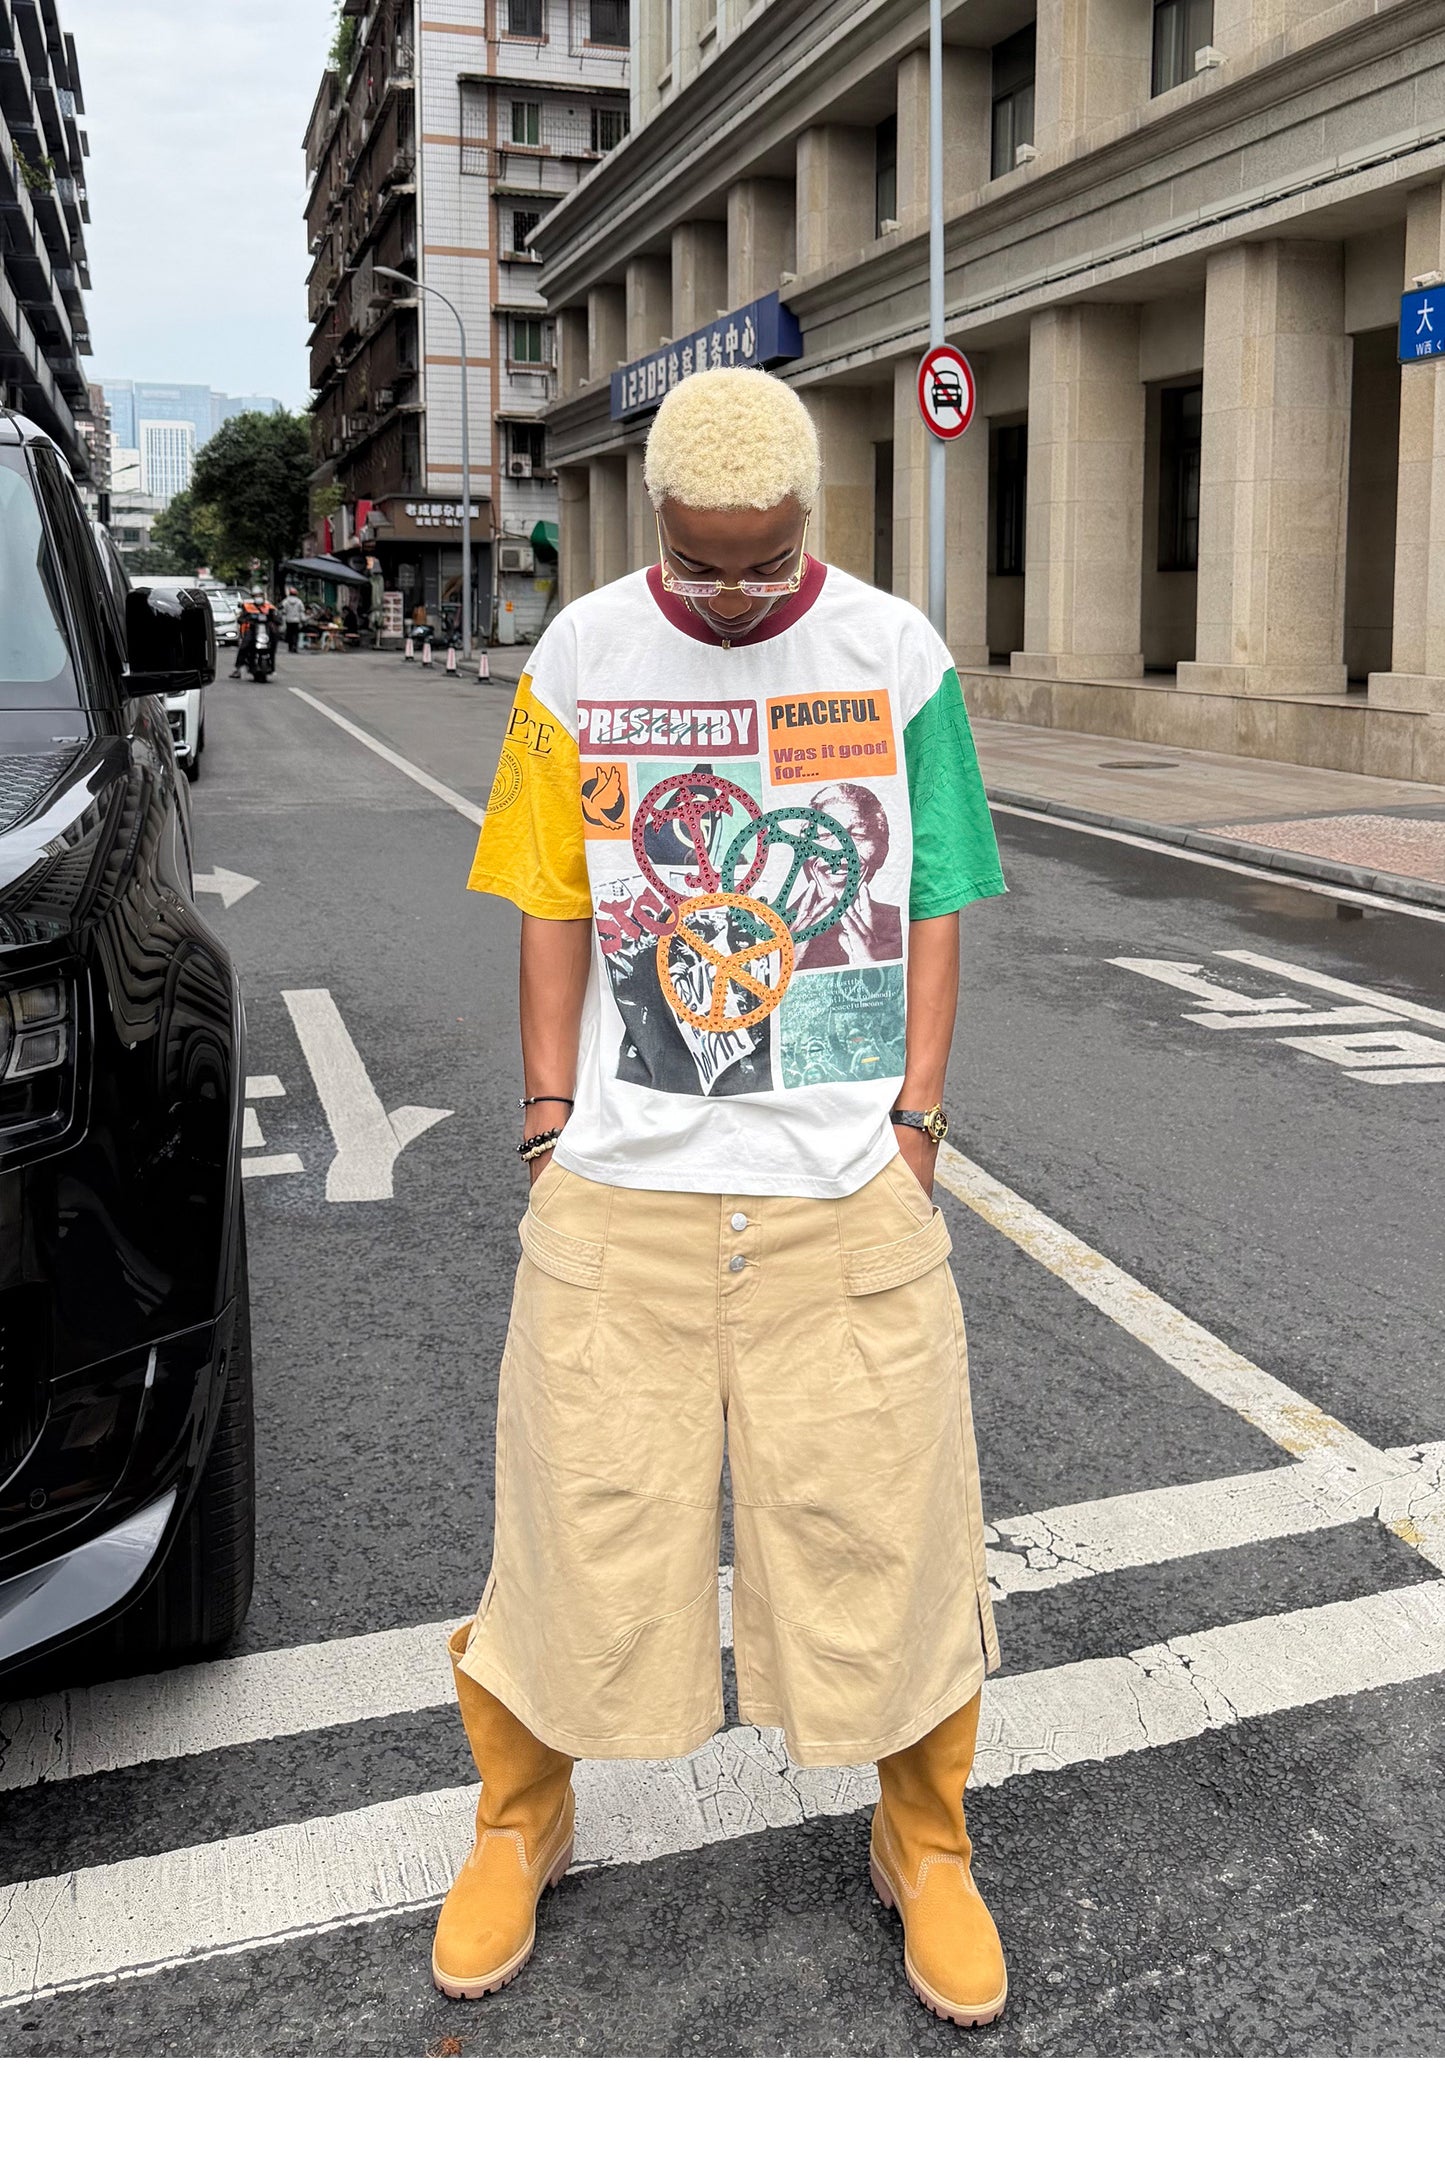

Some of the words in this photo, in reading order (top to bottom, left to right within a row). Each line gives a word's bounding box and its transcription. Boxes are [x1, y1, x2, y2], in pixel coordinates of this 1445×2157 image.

[770, 699, 880, 730] PEACEFUL
[773, 747, 817, 763] Was
[821, 744, 835, 758] it
[838, 741, 888, 758] good
